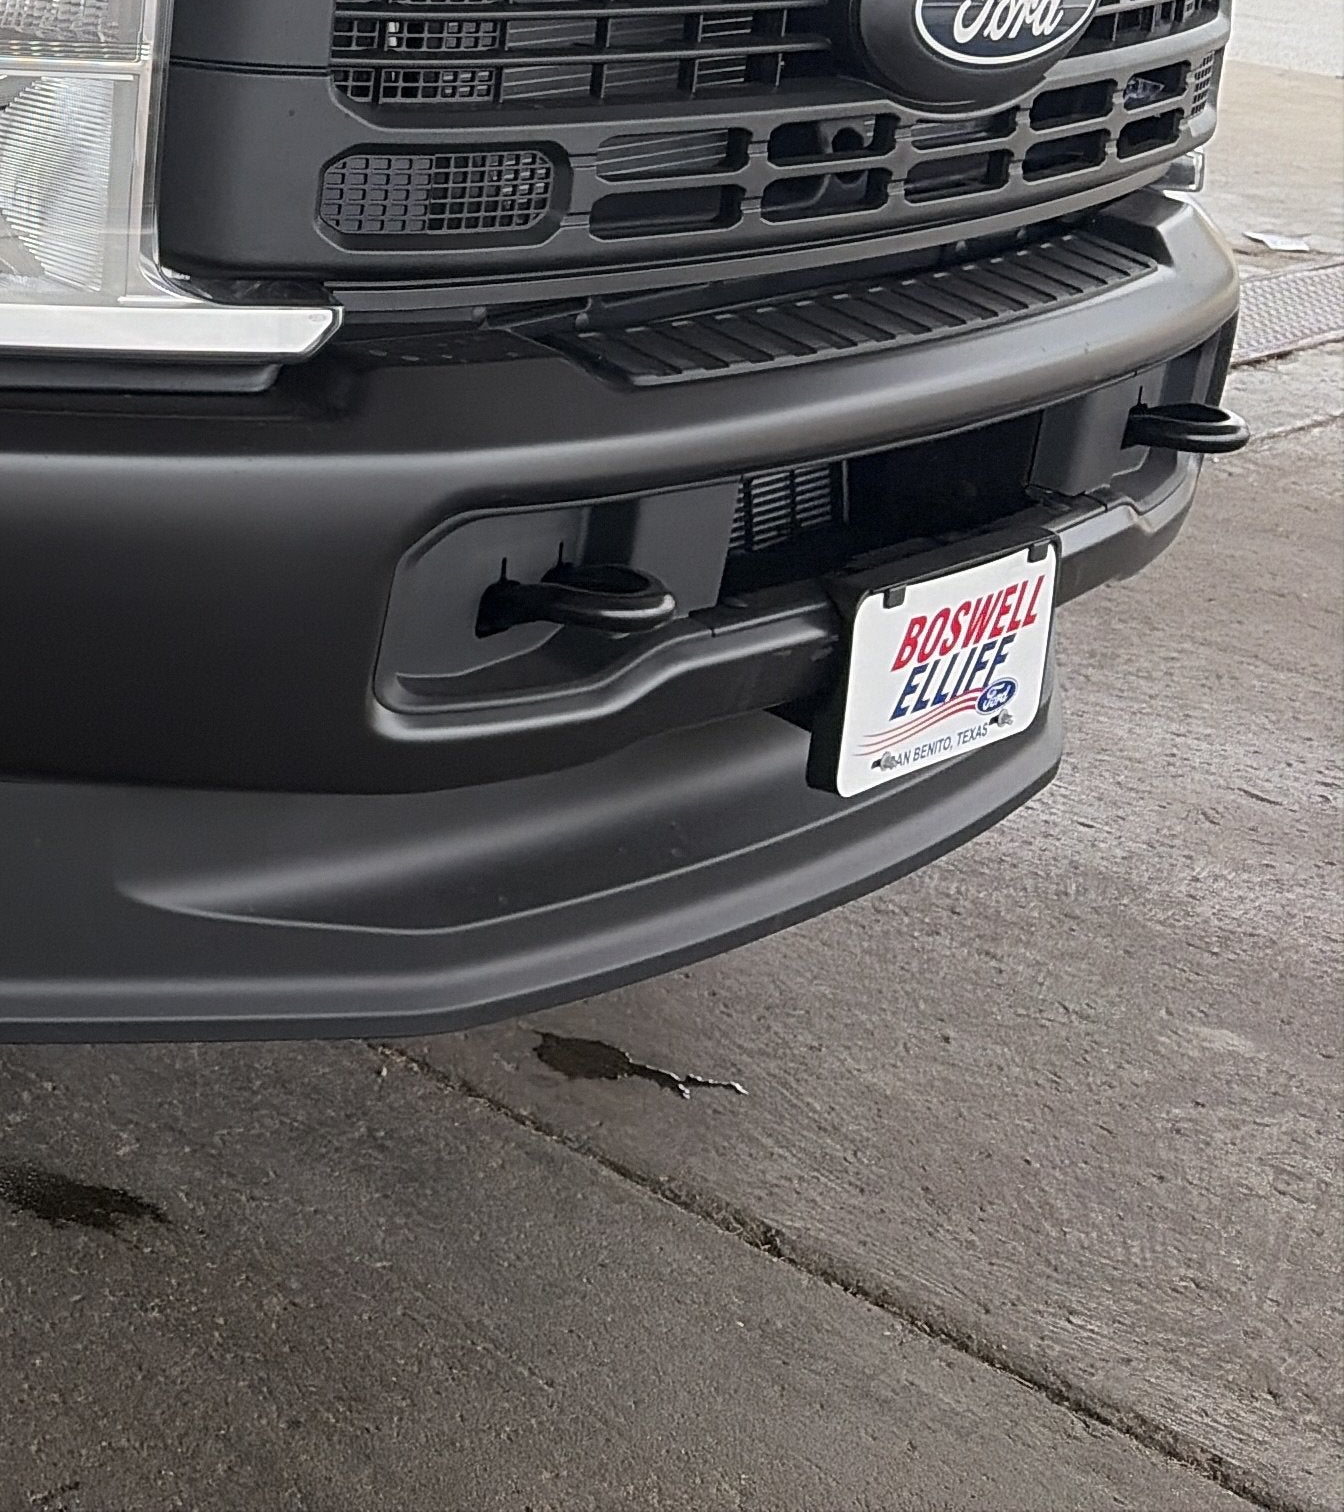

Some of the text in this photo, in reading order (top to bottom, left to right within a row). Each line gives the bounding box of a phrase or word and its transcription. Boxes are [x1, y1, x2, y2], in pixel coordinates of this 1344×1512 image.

[891, 574, 1046, 672] BOSWELL
[889, 633, 1017, 721] ELLIFF
[982, 685, 1012, 709] Ford
[912, 737, 953, 761] BENITO,
[956, 723, 990, 746] TEXAS
